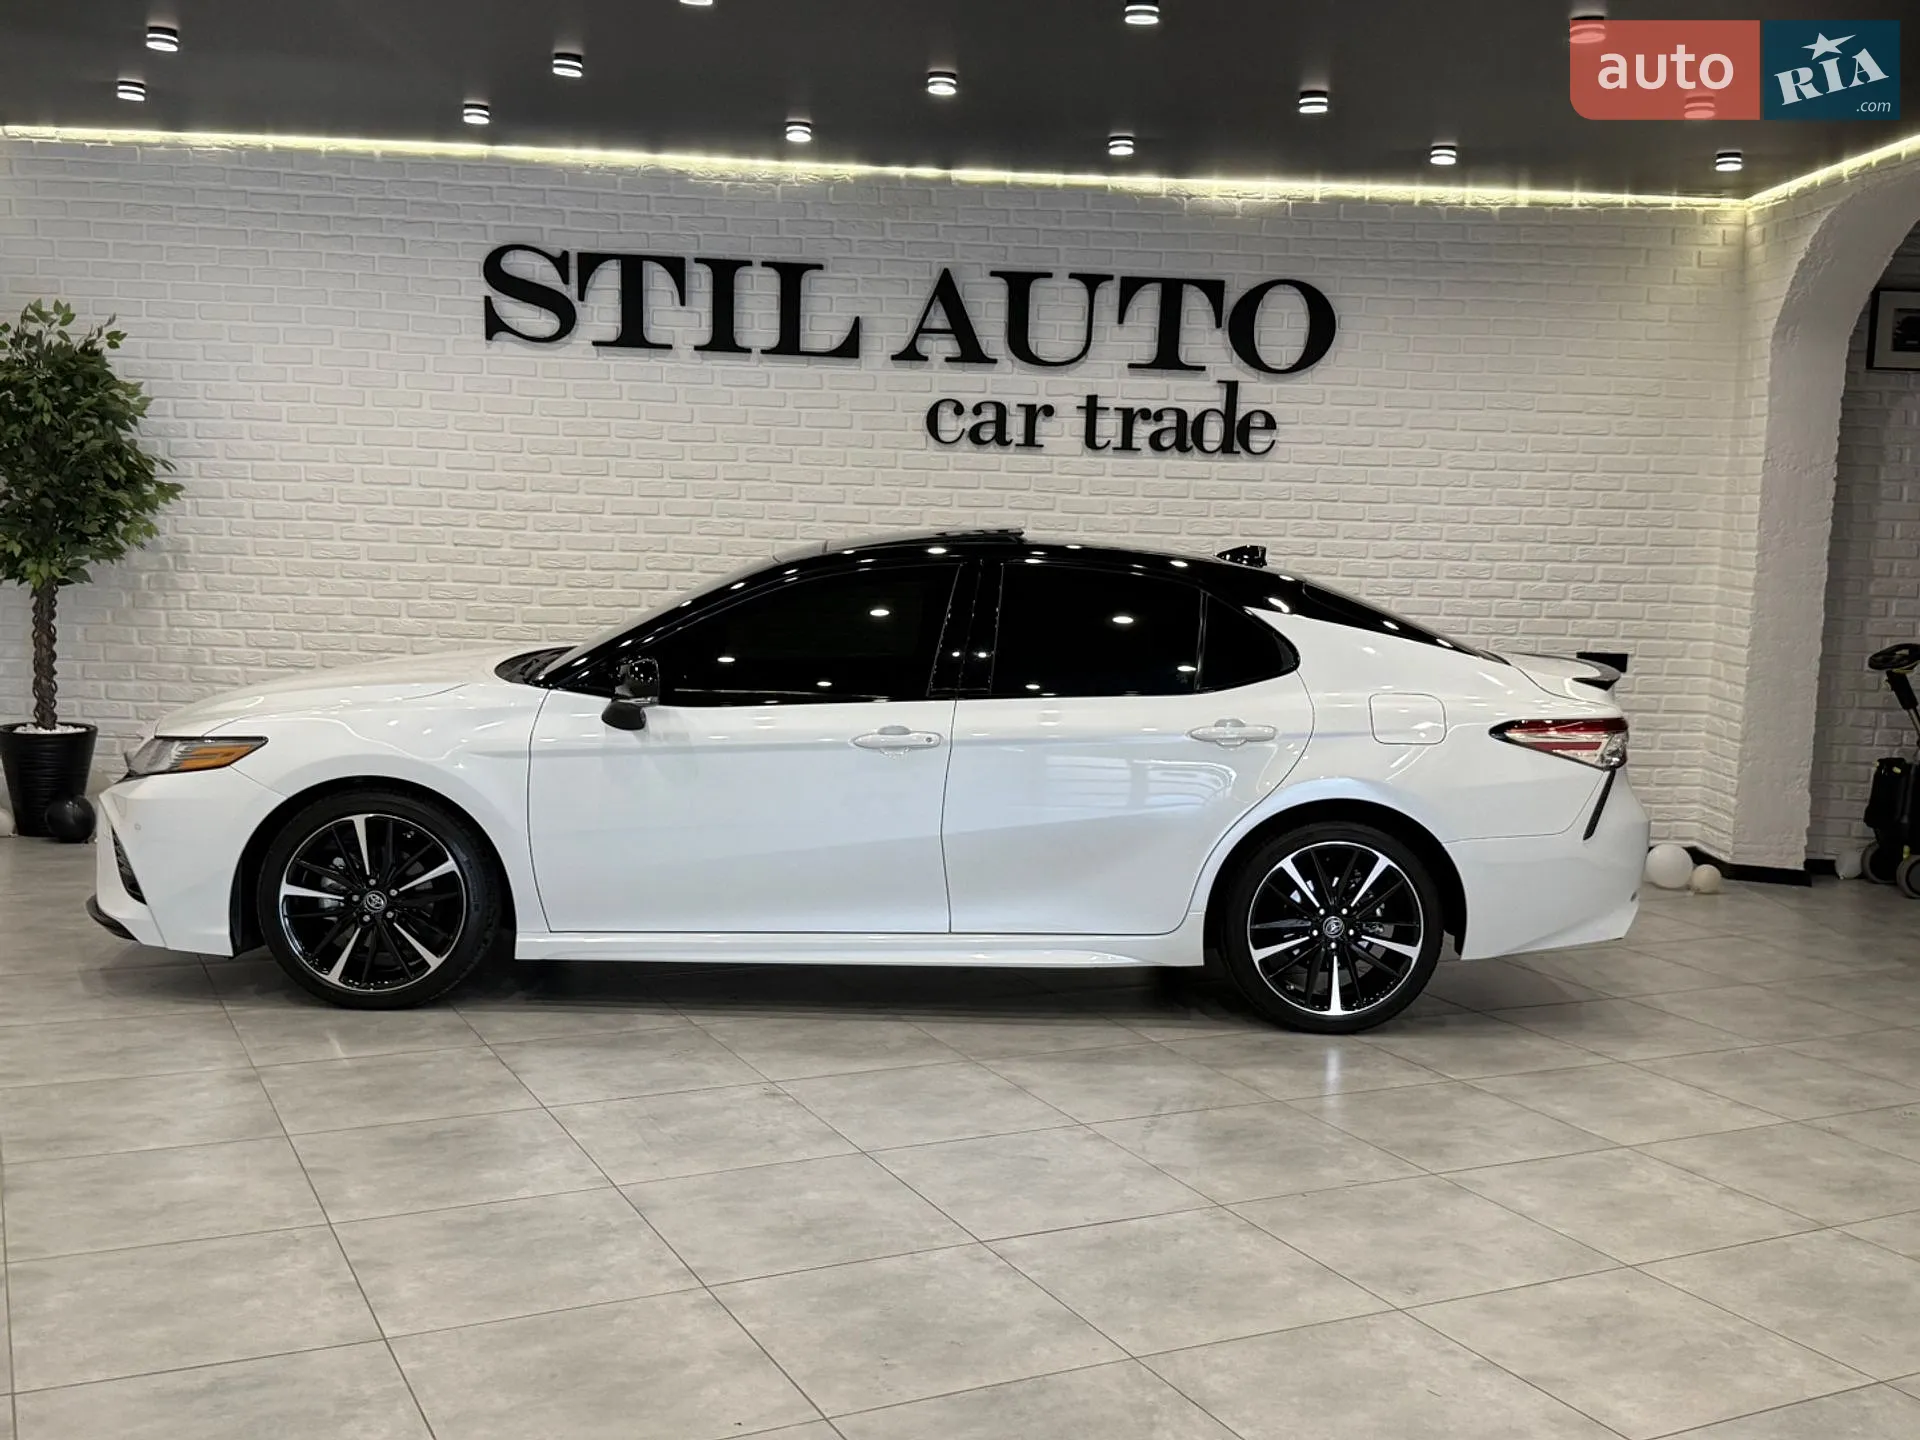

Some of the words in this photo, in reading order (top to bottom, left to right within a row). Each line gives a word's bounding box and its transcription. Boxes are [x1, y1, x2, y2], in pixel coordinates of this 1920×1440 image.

[482, 243, 861, 360] STIL
[890, 267, 1337, 375] AUTO
[925, 398, 1055, 449] car
[1076, 379, 1277, 456] trade
